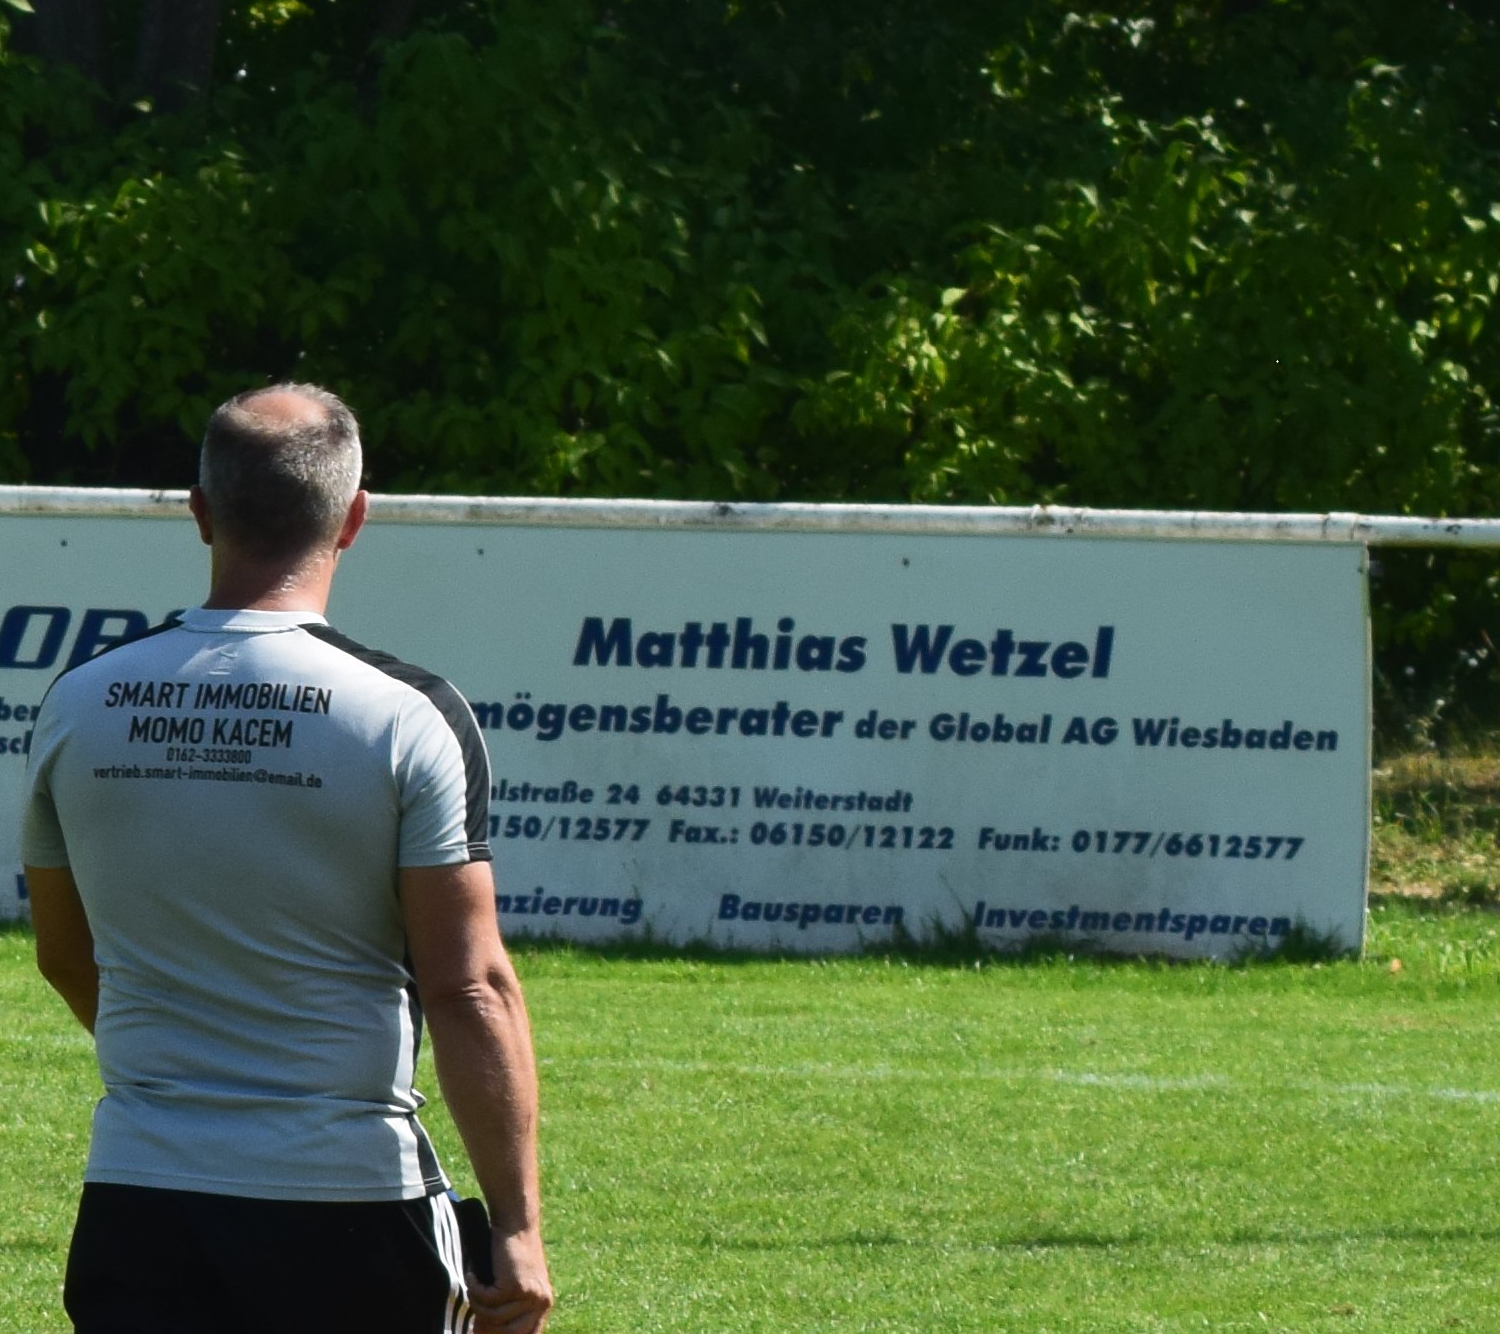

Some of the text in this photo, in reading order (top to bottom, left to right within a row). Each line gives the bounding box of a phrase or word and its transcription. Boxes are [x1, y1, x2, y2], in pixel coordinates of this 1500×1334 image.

[572, 616, 1115, 679] Matthias Wetzel
[104, 681, 333, 715] SMART IMMOBILIEN
[470, 691, 1339, 752] mögensberater der Global AG Wiesbaden
[128, 715, 294, 749] MOMO KACEM
[491, 778, 914, 812] lstraße 24 64331 Weiterstadt
[488, 813, 1305, 861] 150/12577 Fax.: 06150/12122 Funk: 0177/6612577
[495, 886, 1292, 942] nzierung Bausparen Investmentsparen
